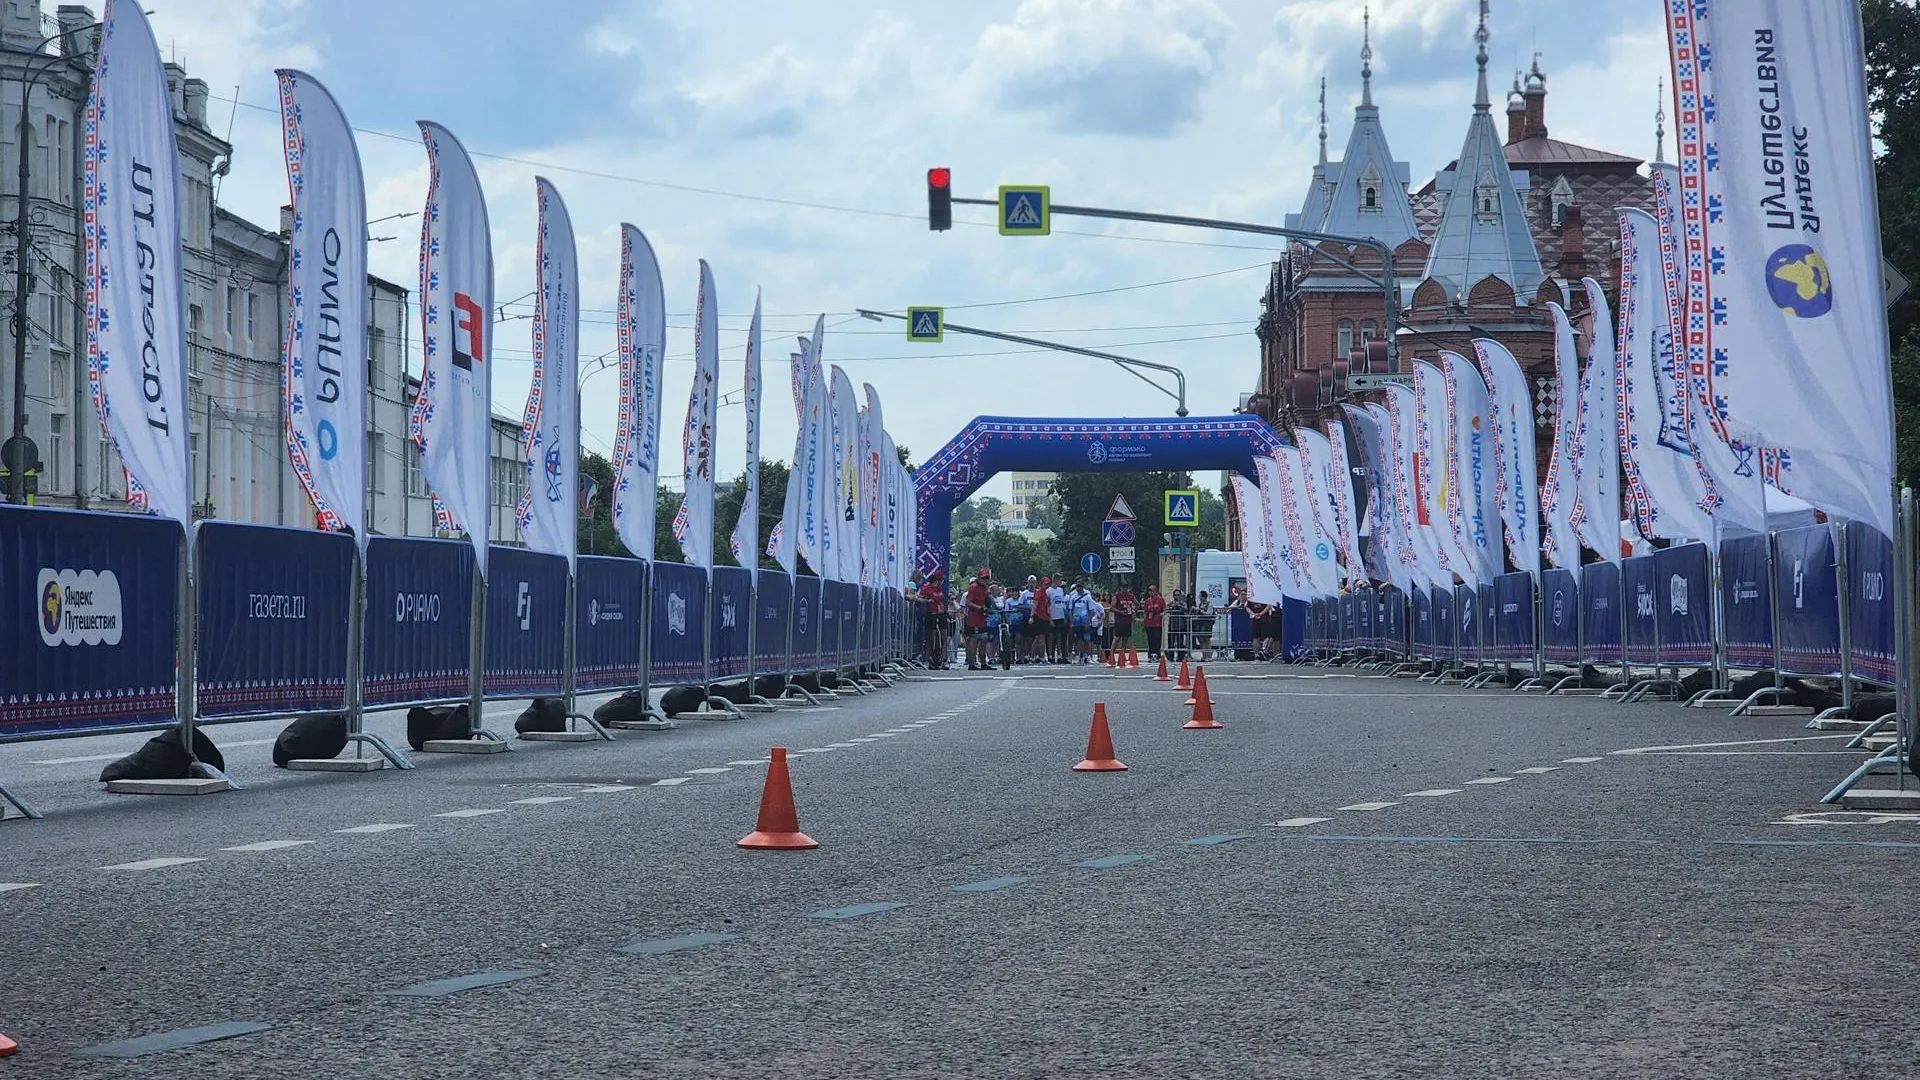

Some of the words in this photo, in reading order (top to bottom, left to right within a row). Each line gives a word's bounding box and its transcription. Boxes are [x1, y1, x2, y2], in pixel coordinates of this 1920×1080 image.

[64, 585, 93, 608] Яндекс
[249, 593, 306, 619] газета.ru
[64, 610, 116, 634] Путешествия
